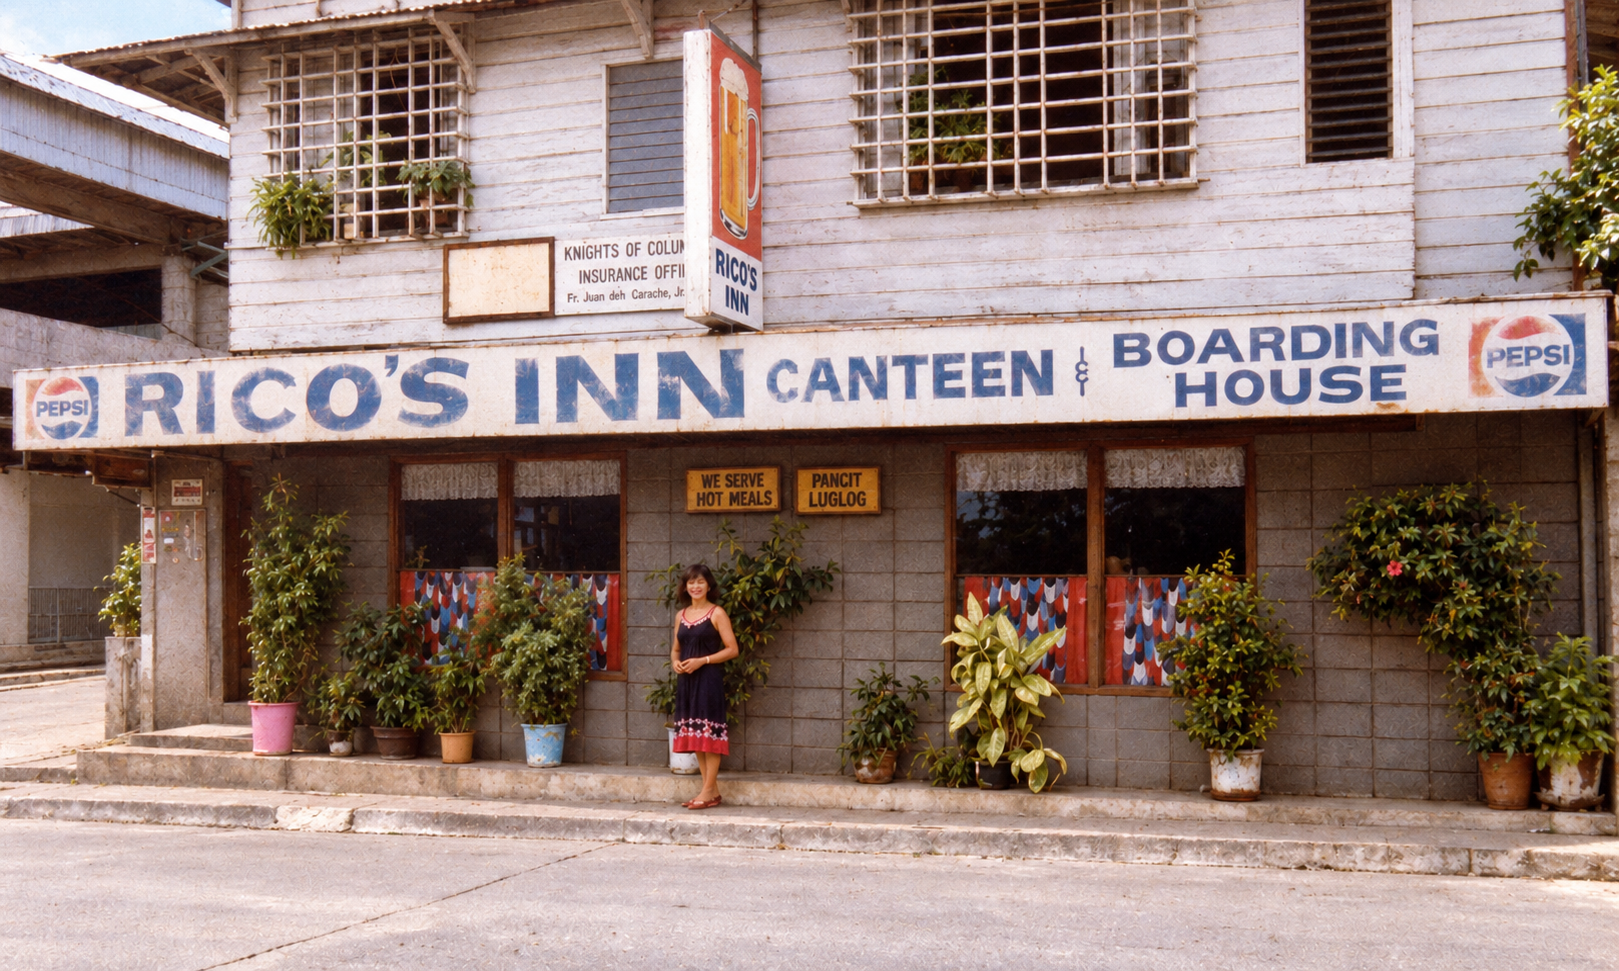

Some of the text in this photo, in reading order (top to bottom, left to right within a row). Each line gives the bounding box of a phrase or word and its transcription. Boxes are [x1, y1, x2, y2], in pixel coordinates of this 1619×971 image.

[565, 243, 620, 261] KNIGHTS
[626, 242, 641, 257] OF
[579, 266, 648, 285] INSURANCE
[715, 247, 757, 292] RICO'S
[567, 293, 580, 303] Fr.
[583, 291, 605, 302] Juan
[674, 285, 685, 297] Jr.
[725, 284, 749, 316] INN
[1113, 319, 1440, 368] BOARDING
[1486, 344, 1571, 369] PEPSI
[124, 354, 470, 437] RICO'S
[515, 348, 745, 425] INN
[766, 348, 1054, 404] CANTEEN
[1175, 364, 1407, 409] HOUSE
[36, 399, 89, 418] PEPSI
[701, 472, 765, 489] WE SERVE
[811, 472, 863, 488] PANCIT
[696, 490, 773, 507] HOT MEALS
[809, 491, 867, 508] LUGLOG
